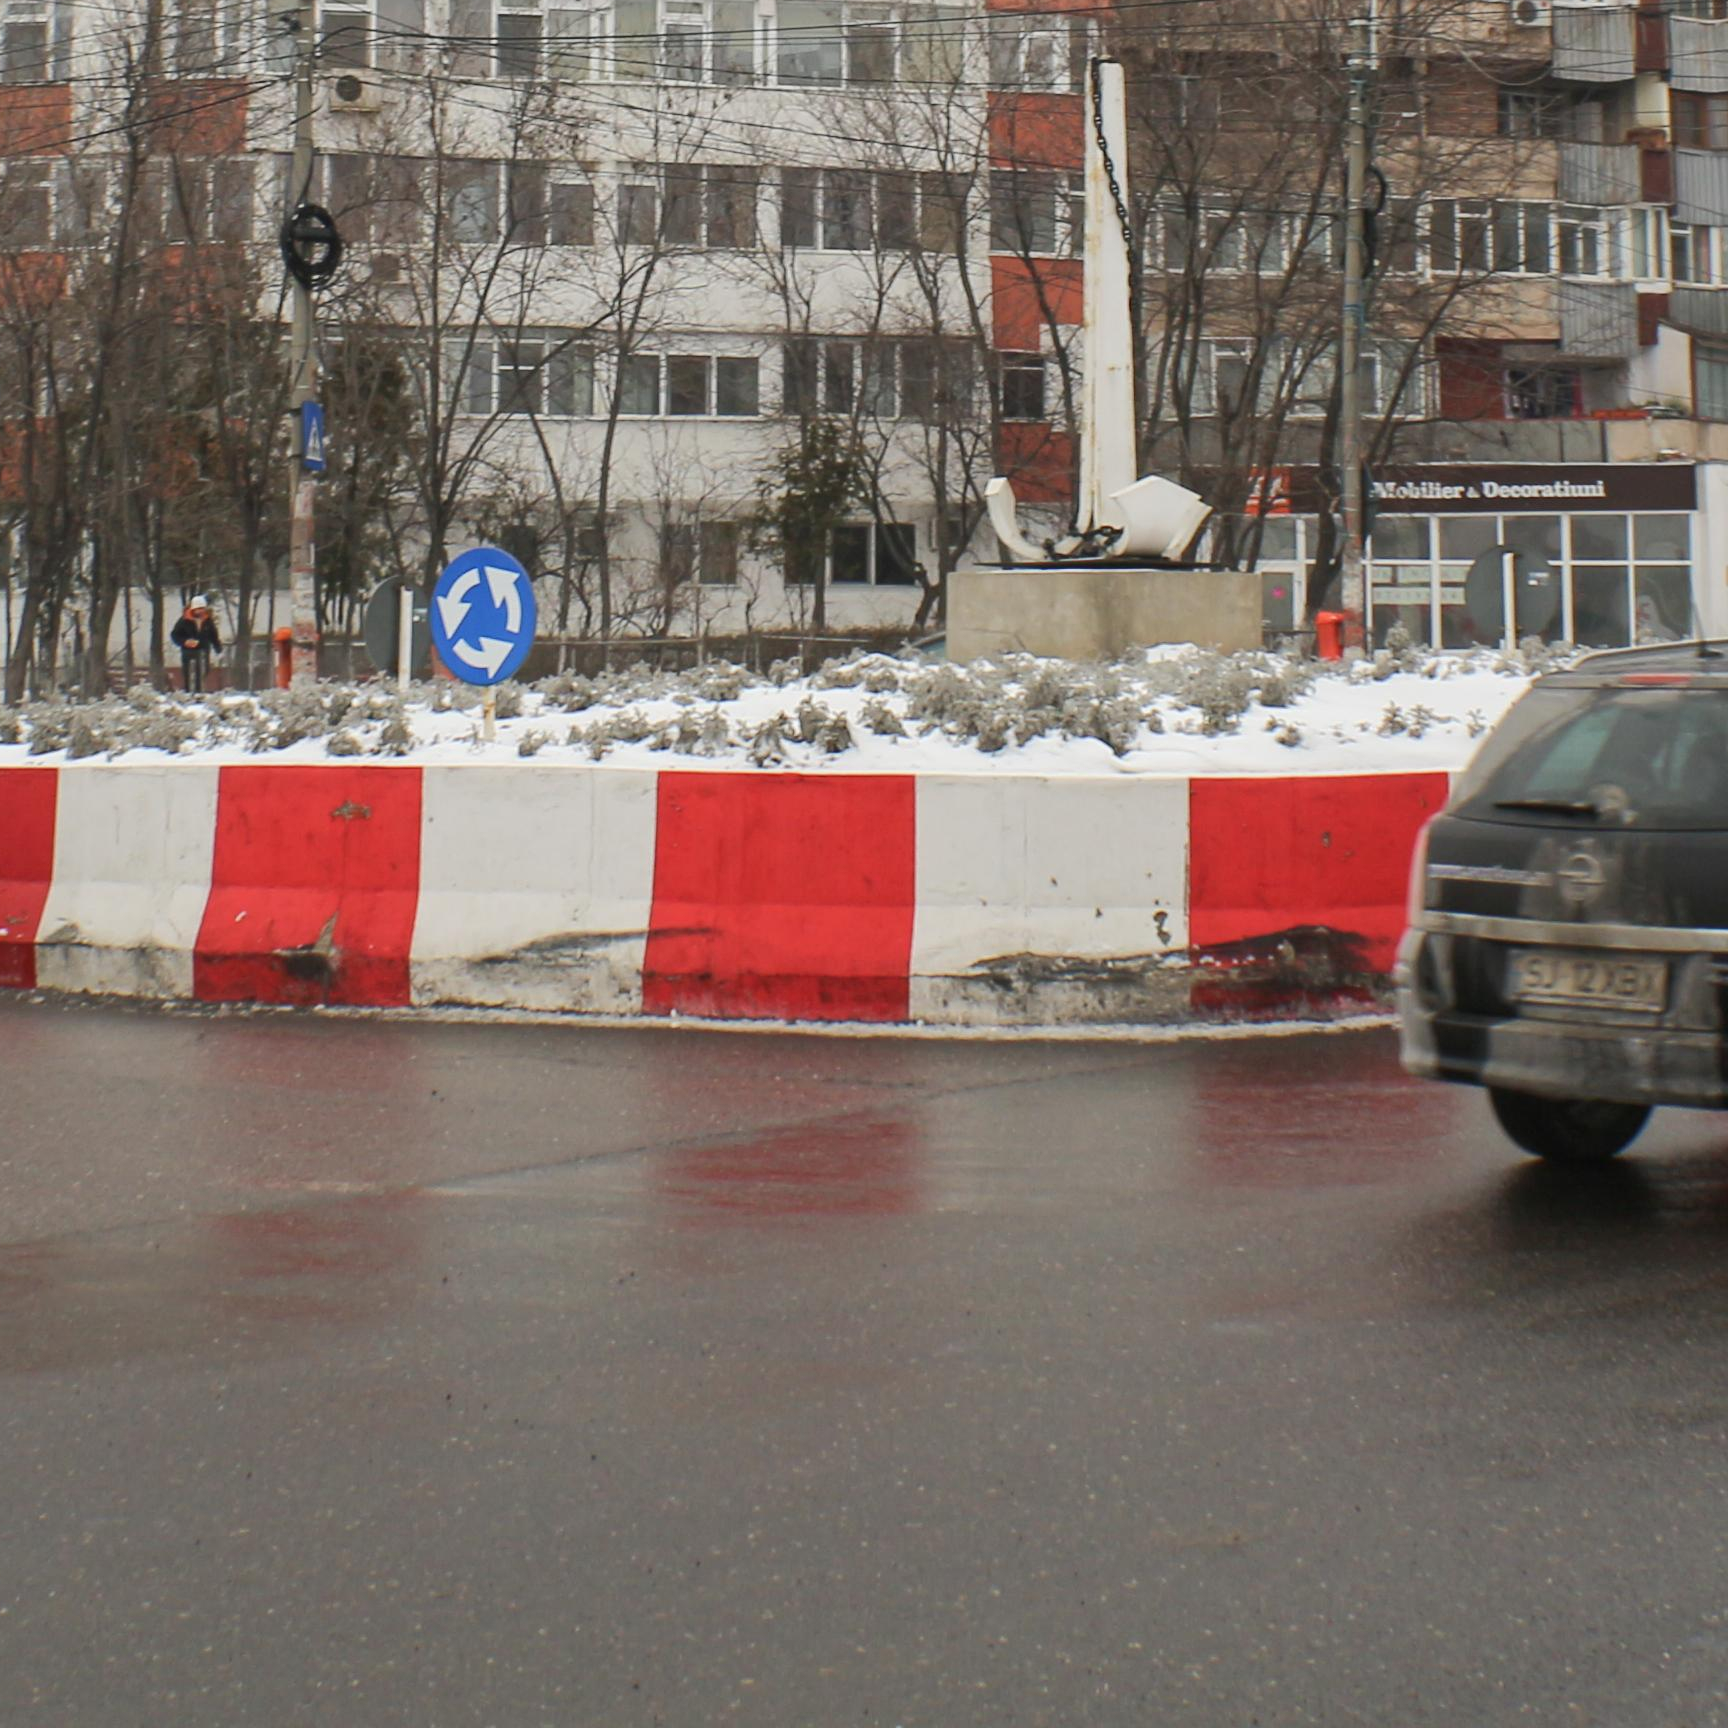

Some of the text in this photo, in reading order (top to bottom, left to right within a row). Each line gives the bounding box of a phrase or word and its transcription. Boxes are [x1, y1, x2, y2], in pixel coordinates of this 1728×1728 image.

[1369, 481, 1466, 499] Mobilier
[1481, 480, 1607, 498] Decoratiuni
[1523, 958, 1558, 990] SJ
